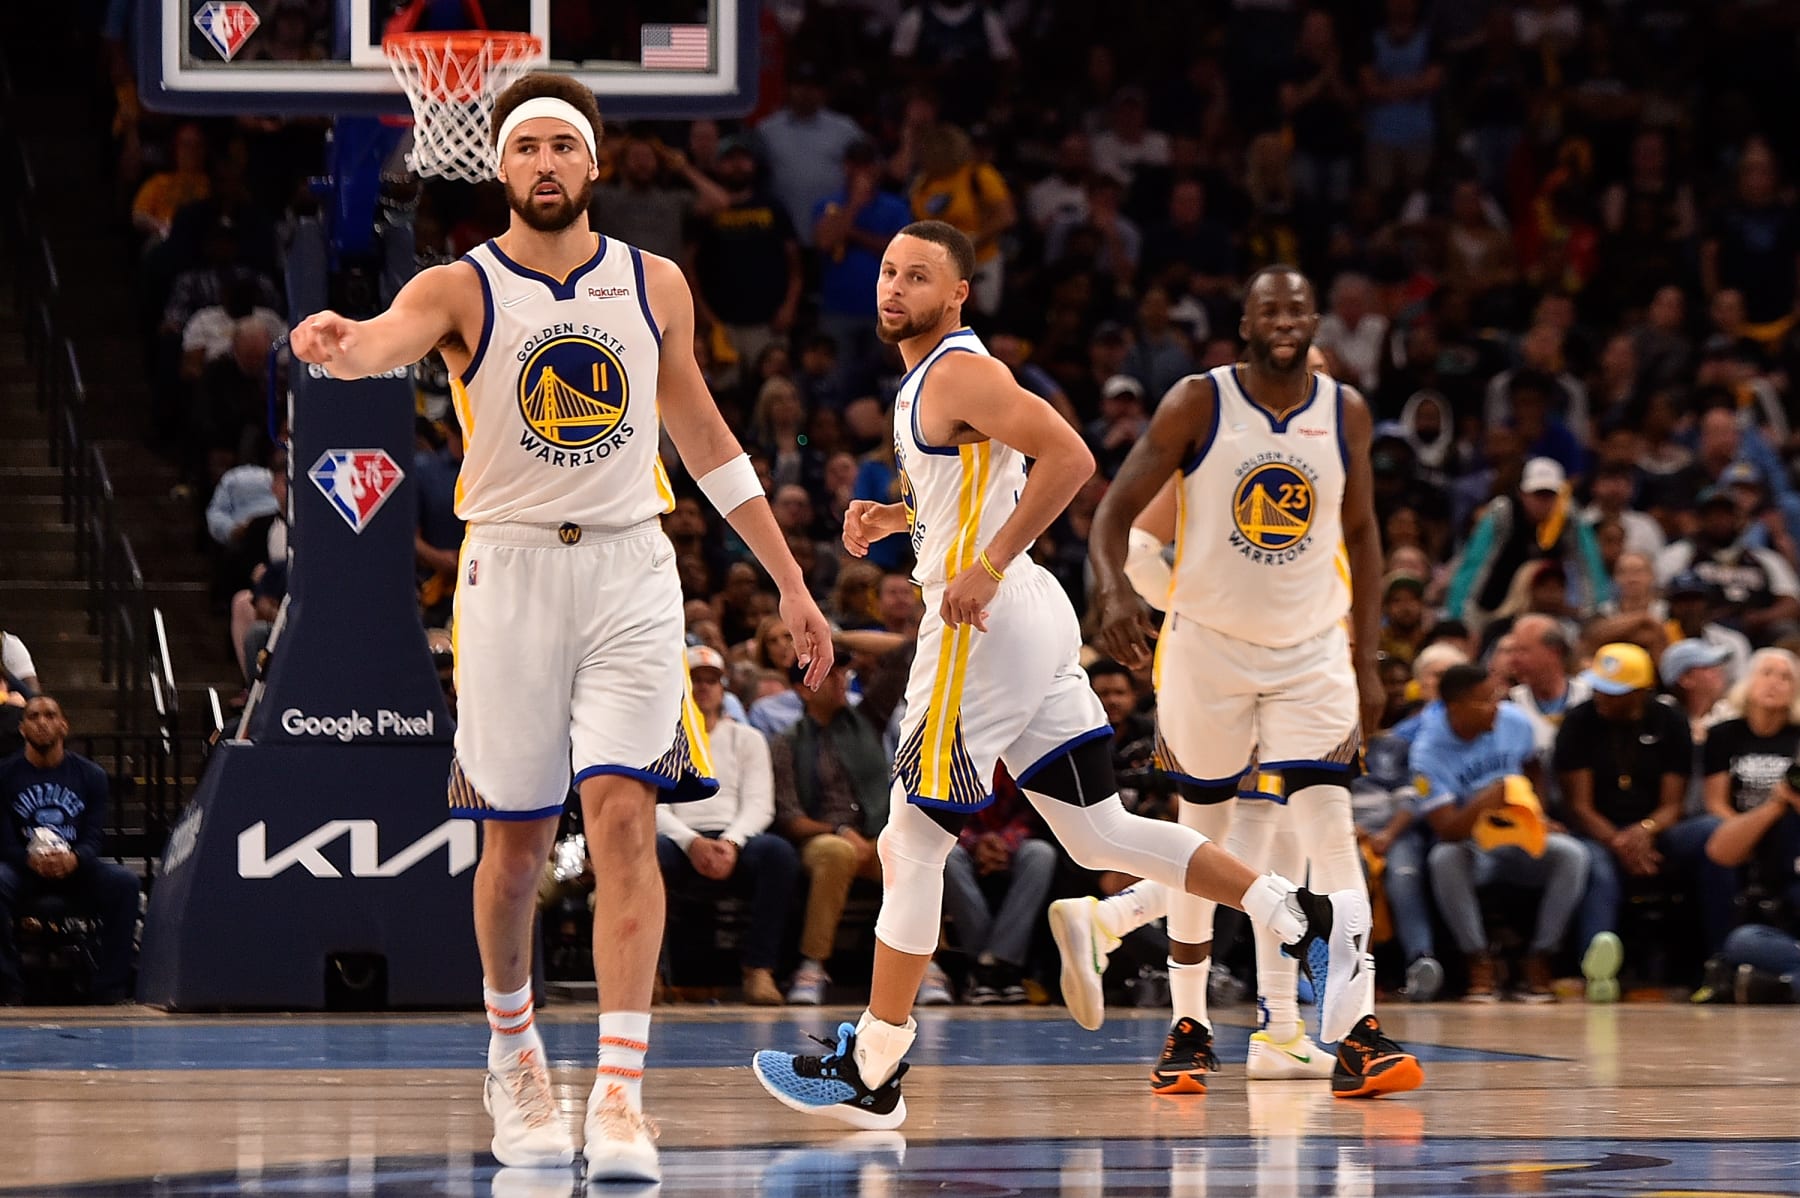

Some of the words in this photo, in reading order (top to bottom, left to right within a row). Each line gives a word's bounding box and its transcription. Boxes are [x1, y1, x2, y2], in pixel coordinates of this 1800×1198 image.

[588, 287, 630, 298] Rakuten
[517, 323, 574, 362] GOLDEN
[582, 324, 626, 355] STATE
[592, 362, 608, 392] 11
[519, 422, 634, 467] WARRIORS
[1234, 451, 1283, 477] GOLDEN
[1279, 483, 1308, 509] 23
[1229, 530, 1313, 566] WARRIORS
[281, 708, 373, 743] Google
[377, 709, 434, 736] Pixel
